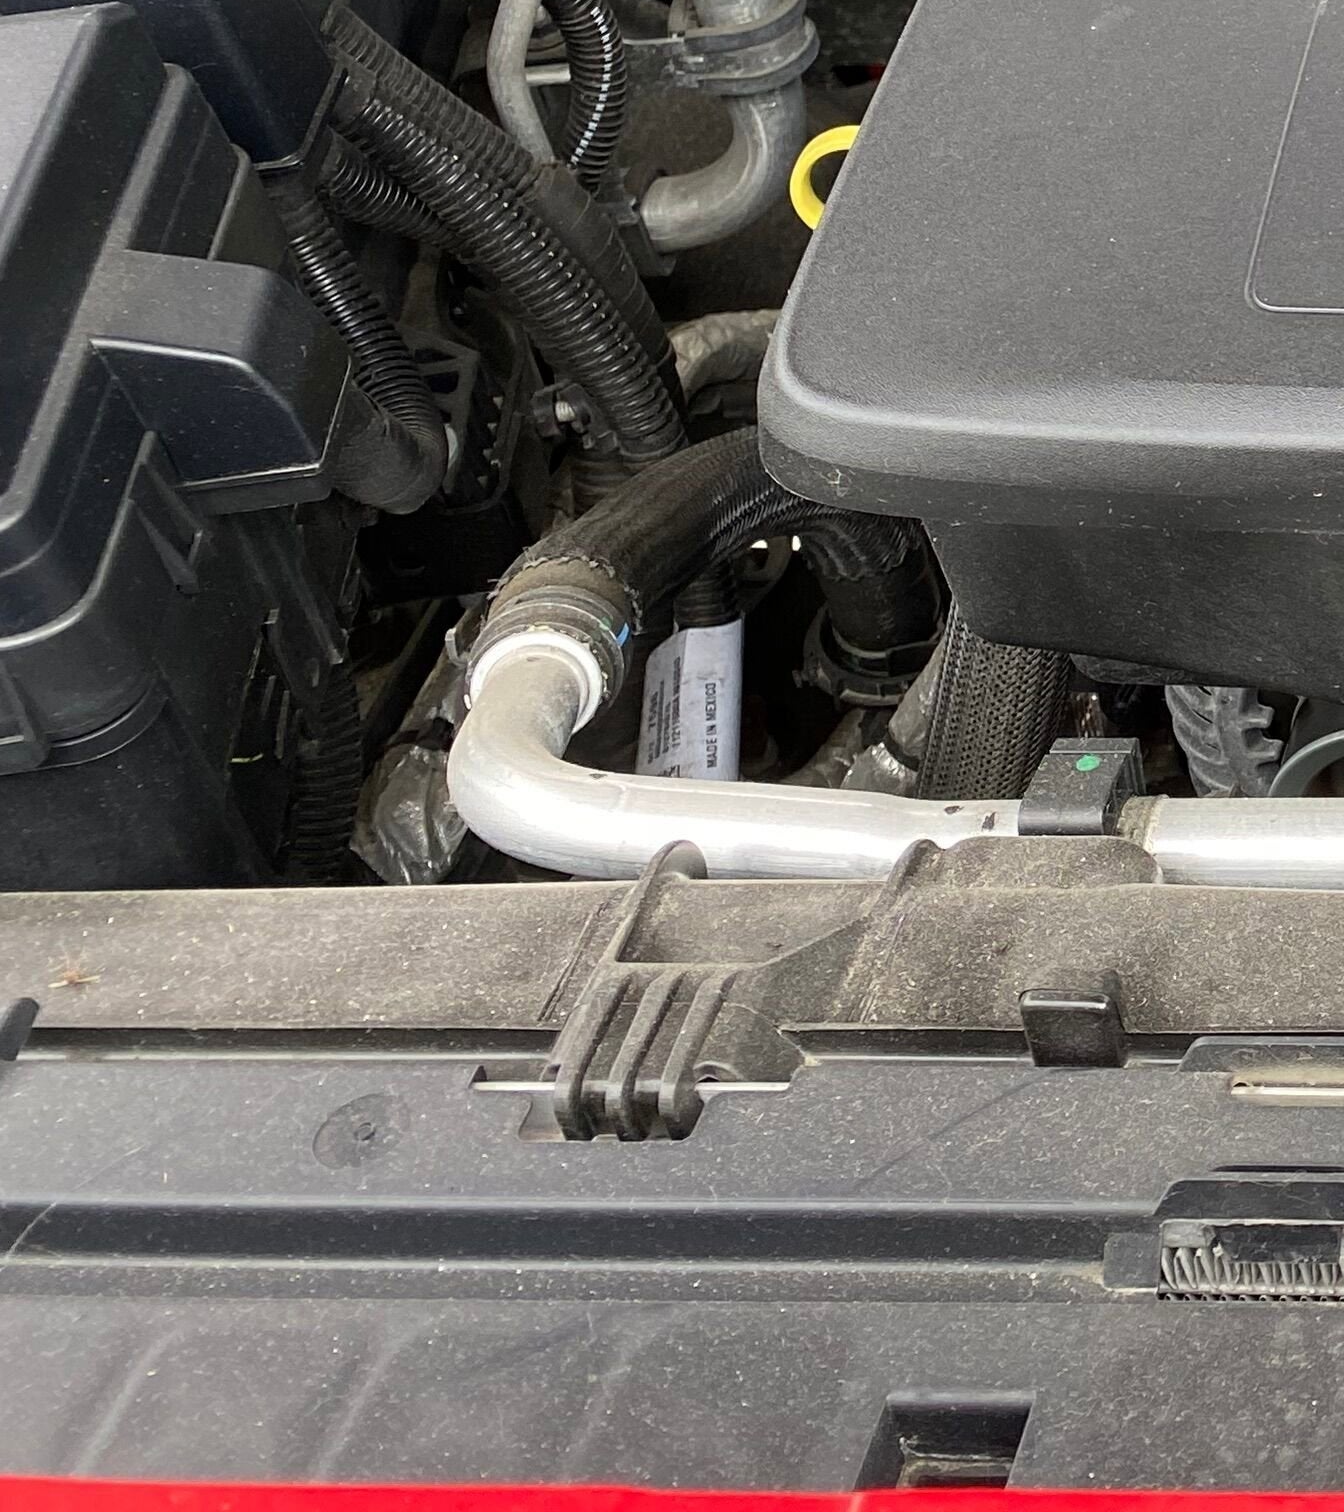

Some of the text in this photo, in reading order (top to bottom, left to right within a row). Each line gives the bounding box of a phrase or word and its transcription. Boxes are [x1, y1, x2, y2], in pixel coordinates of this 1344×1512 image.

[705, 682, 718, 769] MADE IN MEXICO
